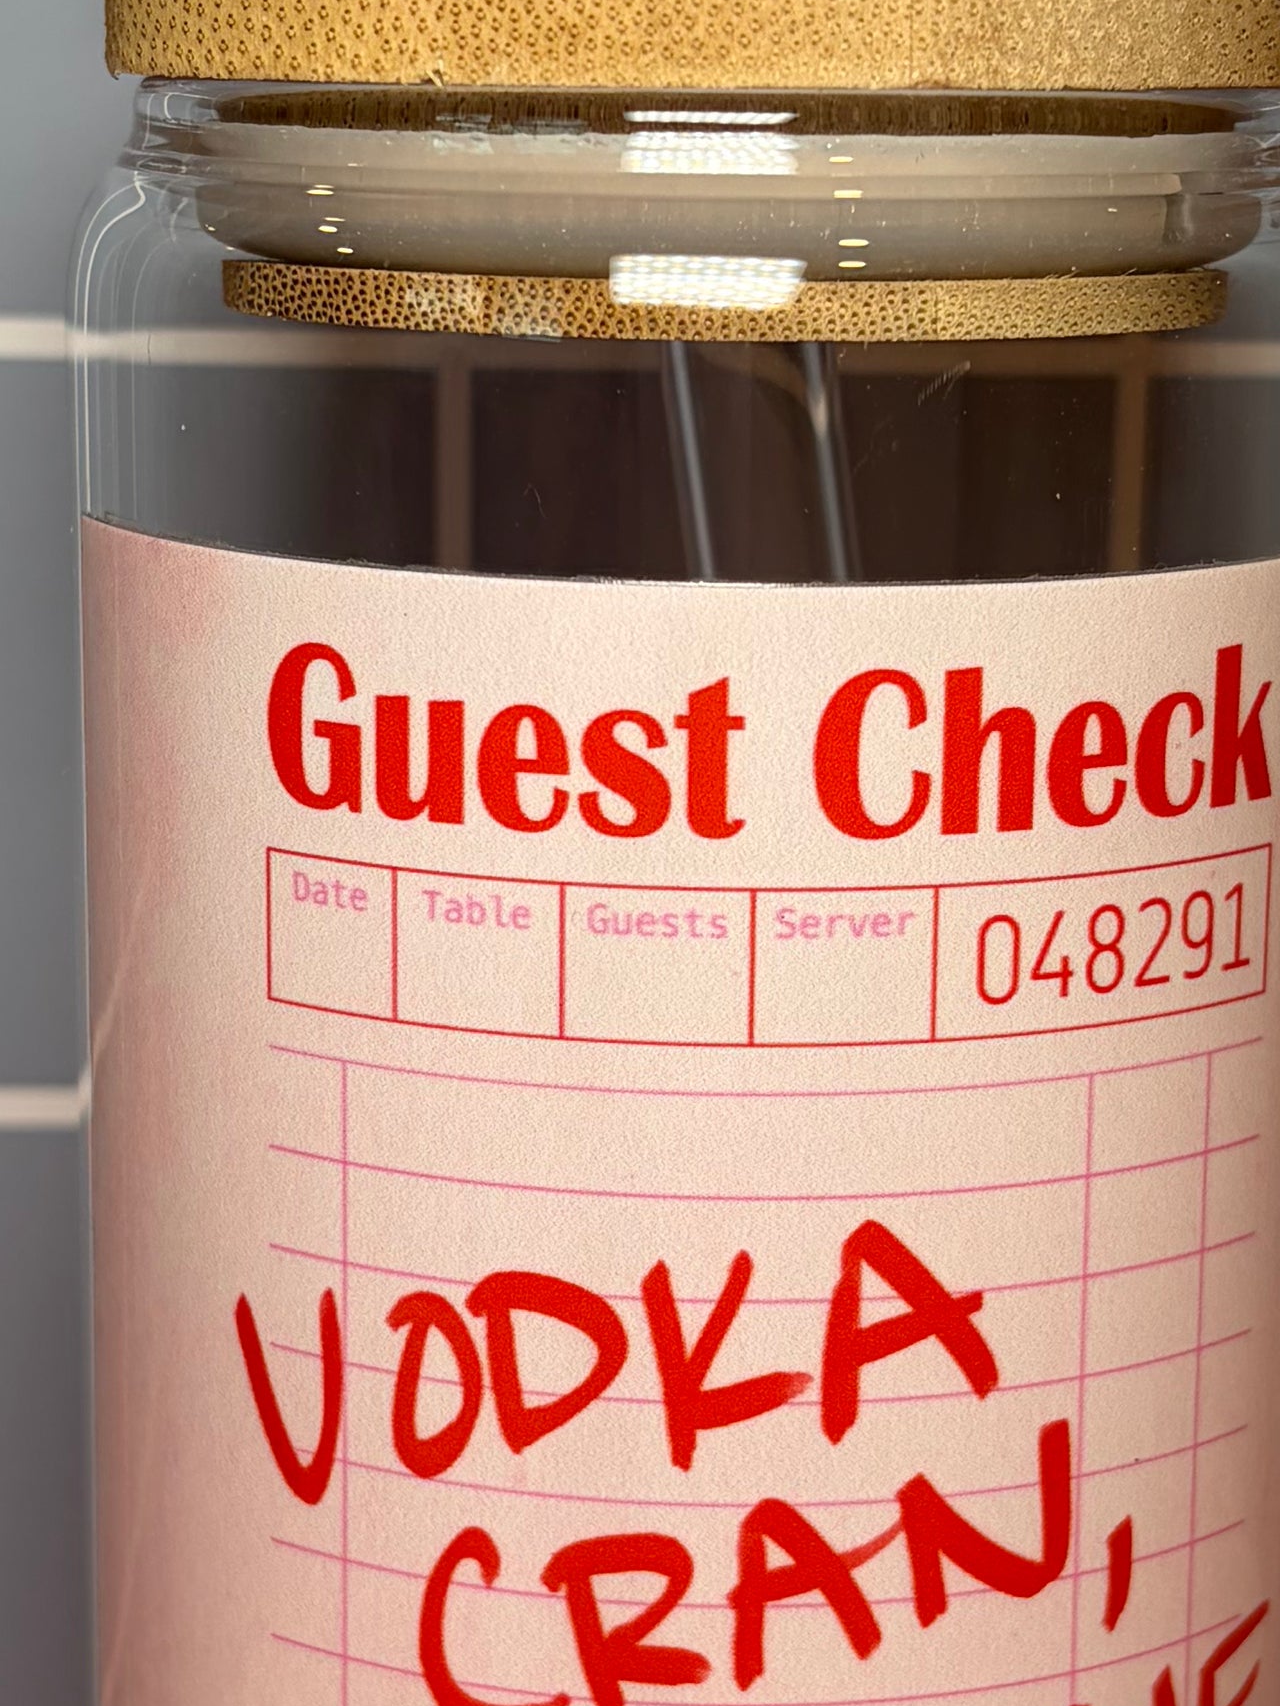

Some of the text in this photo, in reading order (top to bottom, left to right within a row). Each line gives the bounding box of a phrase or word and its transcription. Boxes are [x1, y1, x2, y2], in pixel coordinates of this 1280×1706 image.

[267, 641, 1273, 840] Guest Check
[292, 871, 1251, 1005] Date Table Guests Server 048291
[234, 1218, 999, 1505] VODKA
